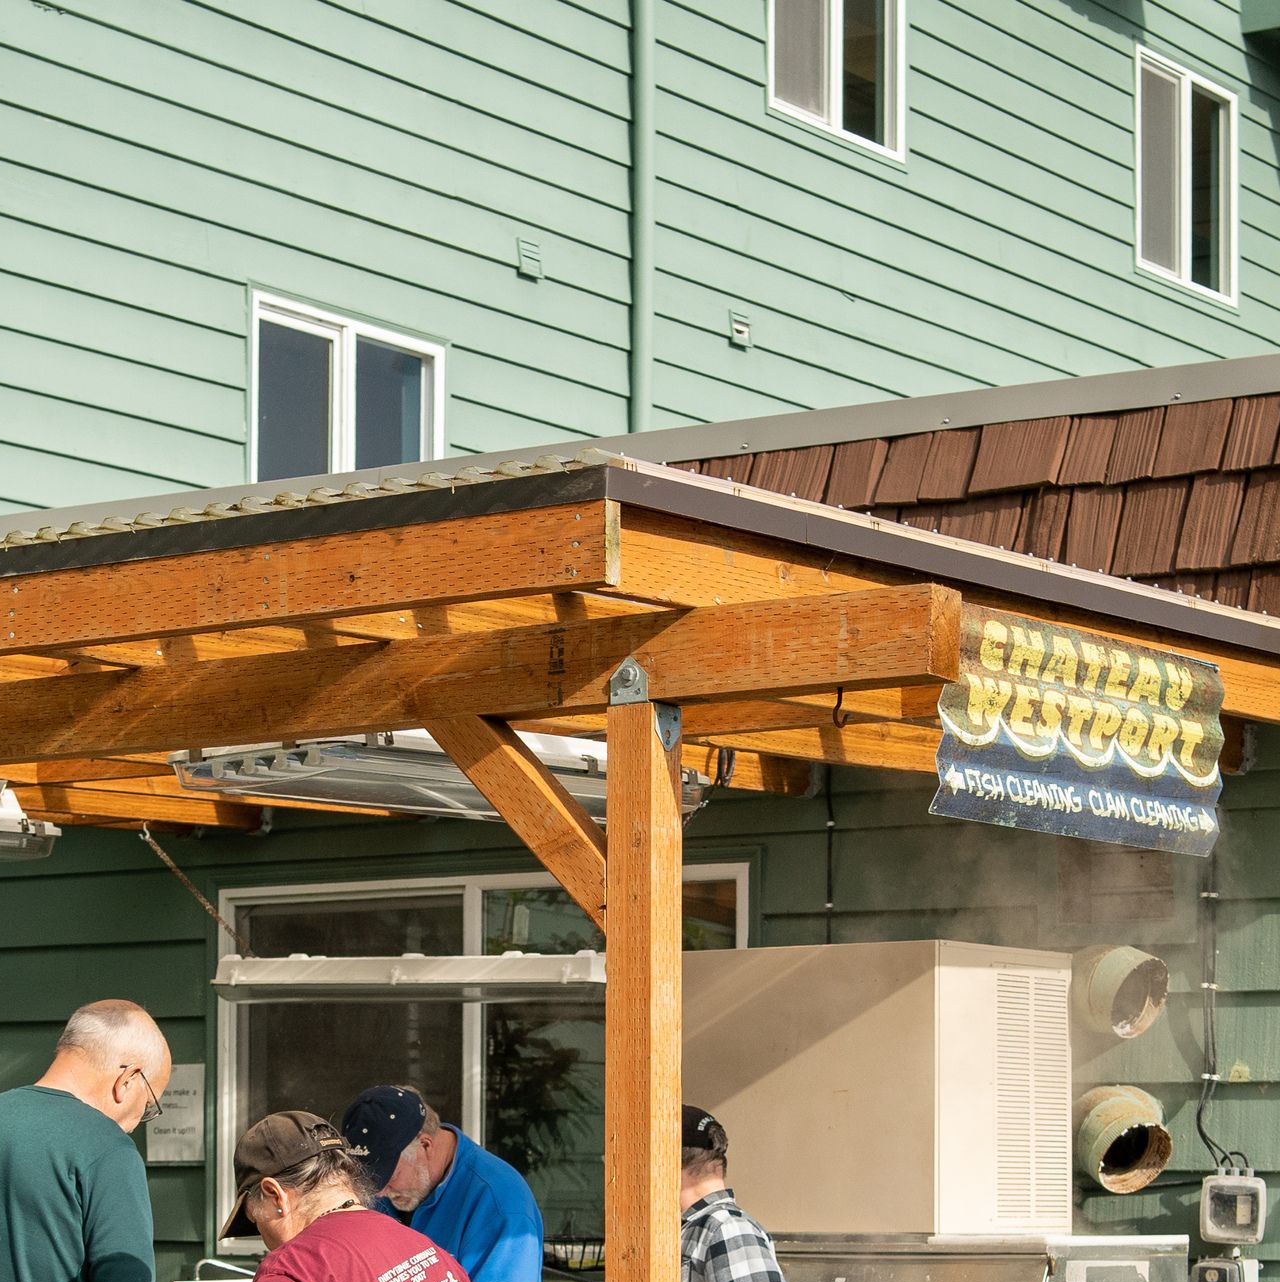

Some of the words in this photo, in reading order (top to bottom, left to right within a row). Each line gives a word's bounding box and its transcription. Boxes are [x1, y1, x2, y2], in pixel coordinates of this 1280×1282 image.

[980, 620, 1193, 711] CHATEAU
[965, 673, 1204, 767] WESTPORT
[964, 768, 1004, 801] FISH
[1006, 775, 1081, 813] CLEANING
[1088, 789, 1129, 821] CLAM
[1130, 797, 1198, 833] CLEANING
[406, 1263, 422, 1277] YOU
